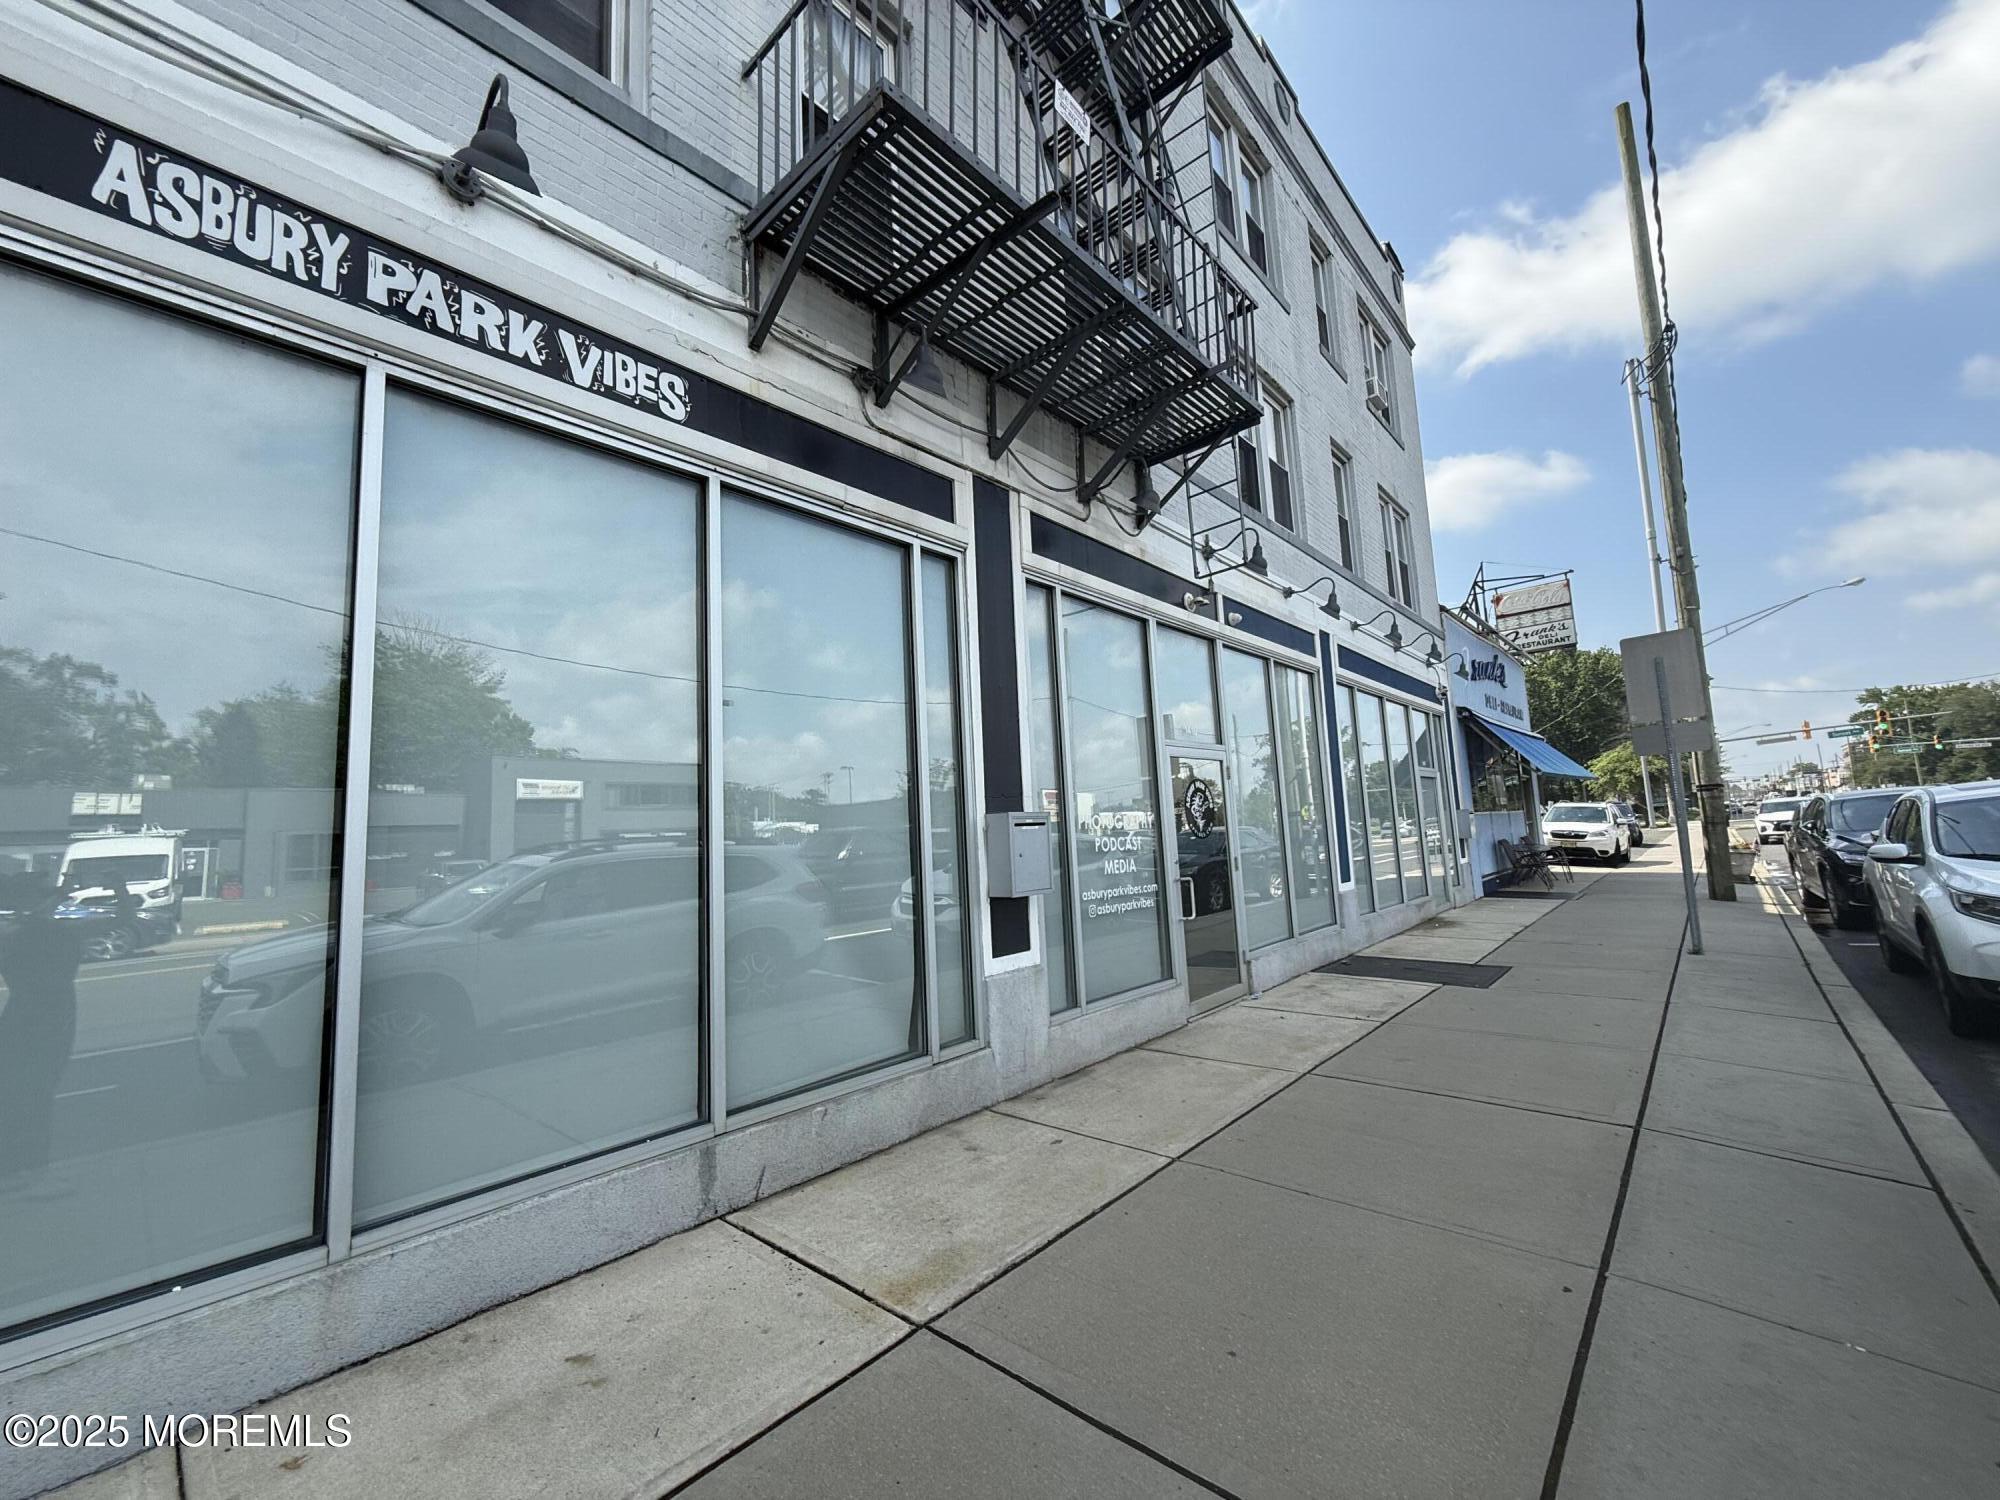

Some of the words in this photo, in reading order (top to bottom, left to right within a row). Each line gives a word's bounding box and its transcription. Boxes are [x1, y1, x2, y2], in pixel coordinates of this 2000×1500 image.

[92, 138, 351, 292] ASBURY
[366, 247, 547, 367] PARK
[557, 329, 687, 424] VIBES
[1538, 632, 1558, 640] DELI
[1095, 836, 1142, 852] PODCAST
[1104, 858, 1136, 875] MEDIA
[1082, 883, 1158, 901] asburyparkvibes.com
[1088, 898, 1155, 918] @asburyparkvibes
